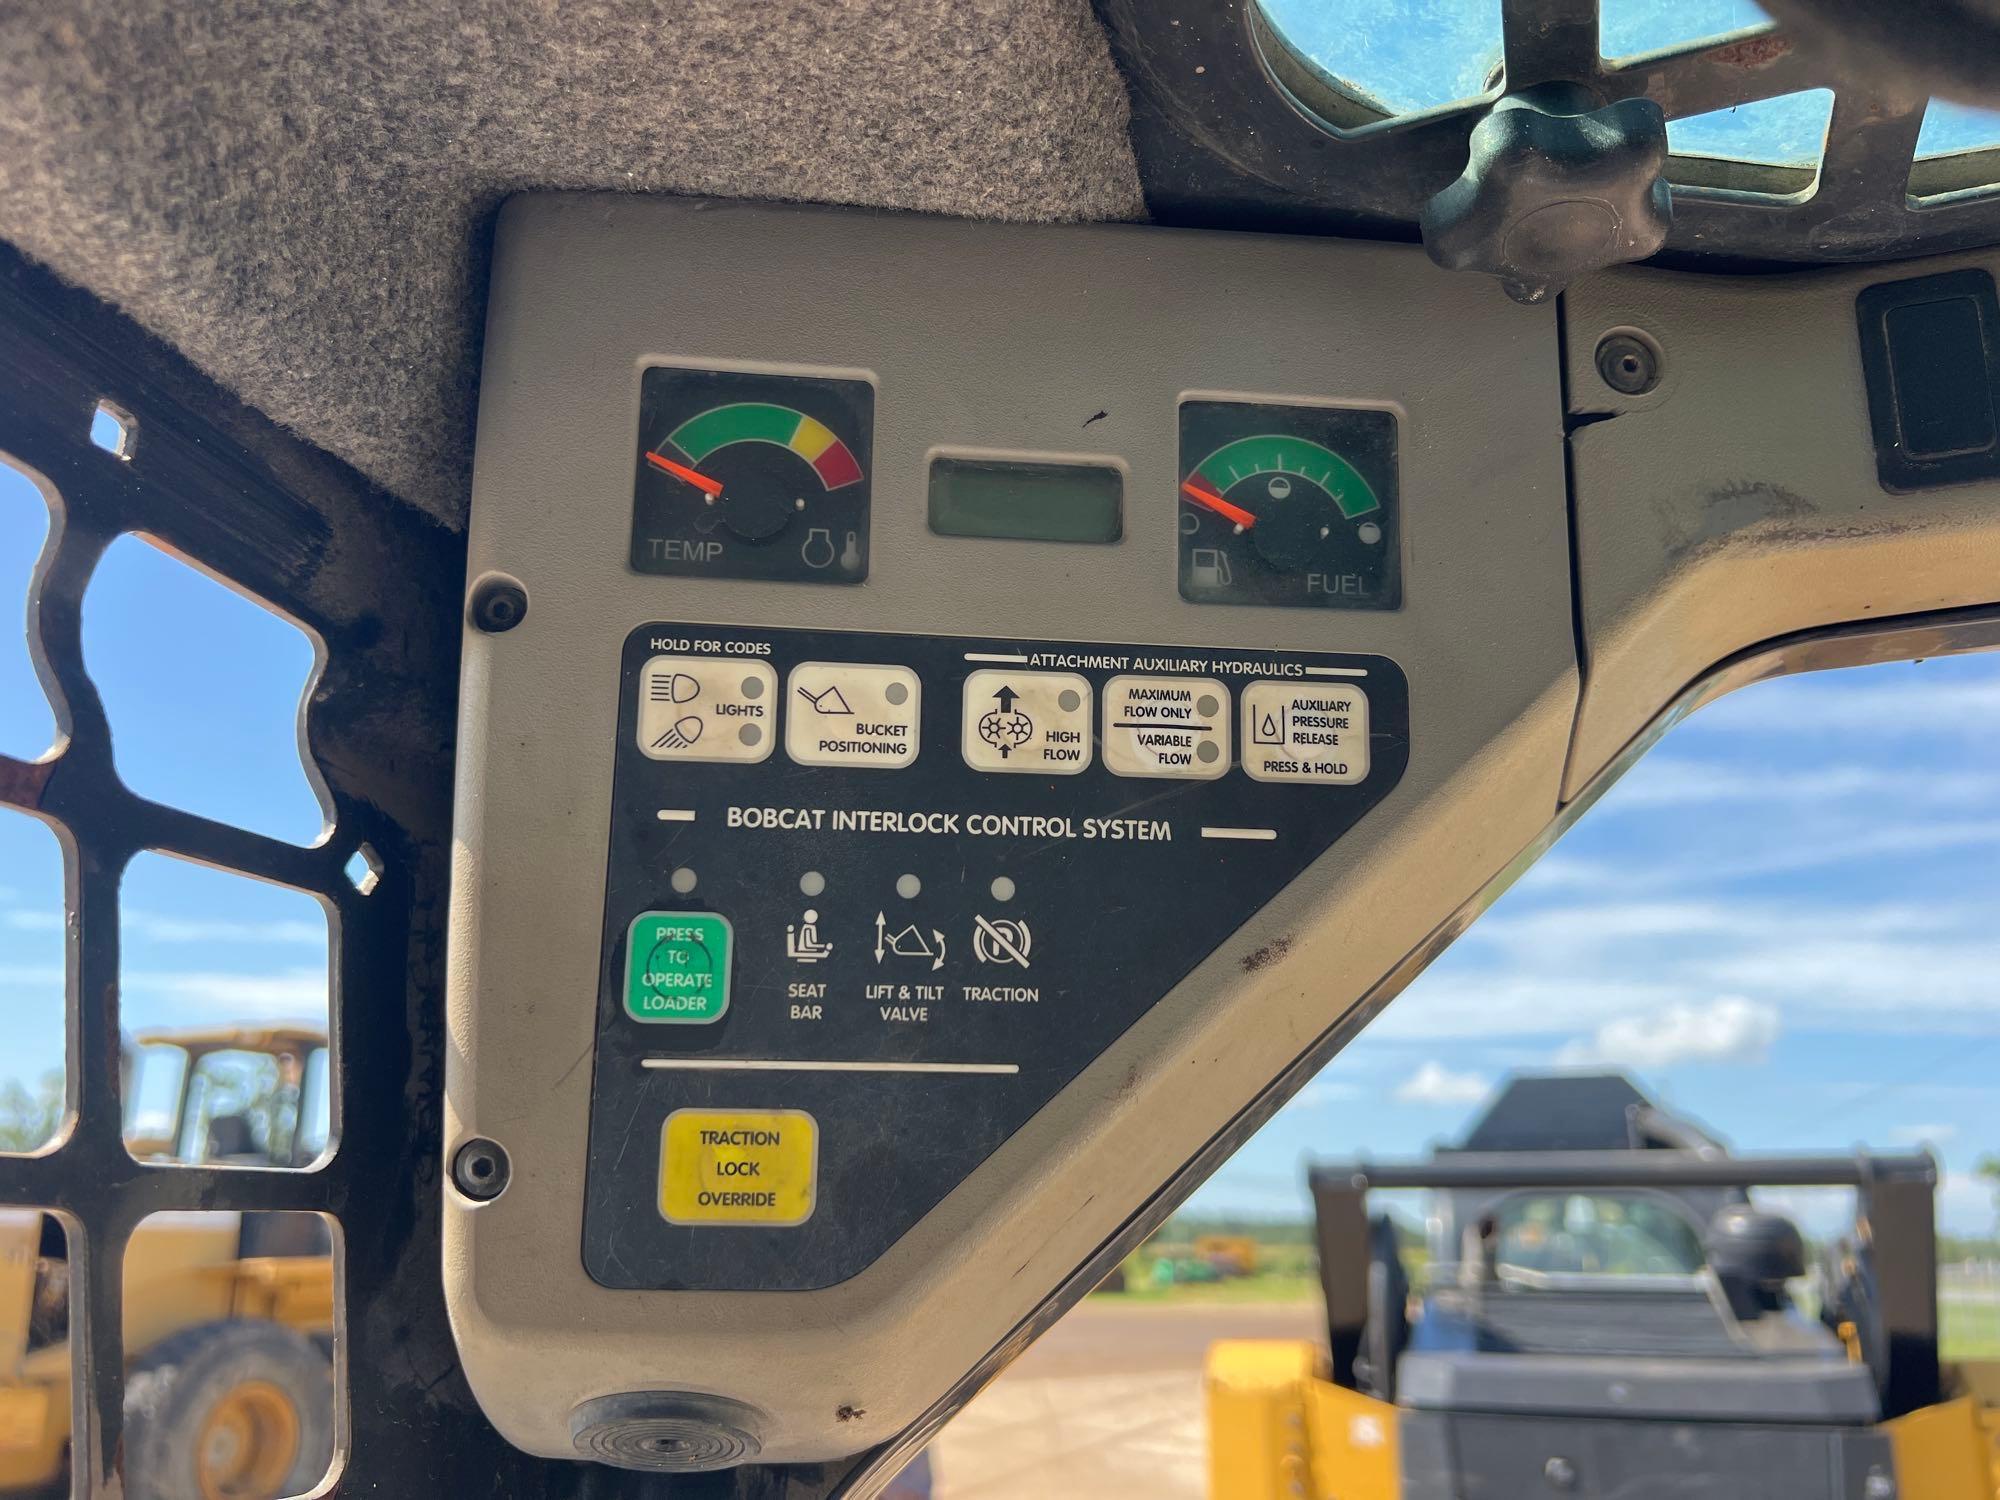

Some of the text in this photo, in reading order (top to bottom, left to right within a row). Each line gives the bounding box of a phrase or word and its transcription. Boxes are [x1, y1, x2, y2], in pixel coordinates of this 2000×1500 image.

[648, 539, 723, 562] TEMP
[1307, 574, 1369, 595] FUEL
[650, 638, 771, 655] HOLD FOR CODES
[1030, 654, 1303, 676] ATTACHMENT AUXILIARY HYDRAULICS
[1129, 689, 1192, 702] MAXIMUM
[716, 704, 764, 717] LIGHTS
[1124, 707, 1192, 719] FLOW ONLY
[1291, 700, 1351, 713] AUXILIARY
[856, 723, 908, 736] BUCKET
[1292, 716, 1349, 729] PRESSURE
[1046, 731, 1081, 743] HIGH
[1137, 735, 1192, 748] VARIABLE
[1292, 733, 1339, 746] RELEASE
[819, 741, 907, 754] POSITIONING
[1043, 749, 1081, 761] FLOW
[1158, 753, 1192, 765] FLOW
[1263, 761, 1348, 775] PRESS & HOLD
[727, 806, 1173, 842] BOBCAT INTERLOCK CONTROL SYSTEM
[656, 927, 705, 942] PRESS
[668, 950, 690, 964] TO
[642, 973, 713, 988] OPERATE
[788, 983, 827, 998] SEAT
[866, 985, 945, 1000] LIFT & TILT
[963, 986, 1040, 1003] TRACTION
[643, 996, 707, 1011] LOADER
[790, 1005, 823, 1020] BAR
[880, 1006, 928, 1022] VALVE
[700, 1130, 780, 1146] TRACTION
[717, 1161, 760, 1176] LOCK
[697, 1191, 776, 1207] OVERRIDE
